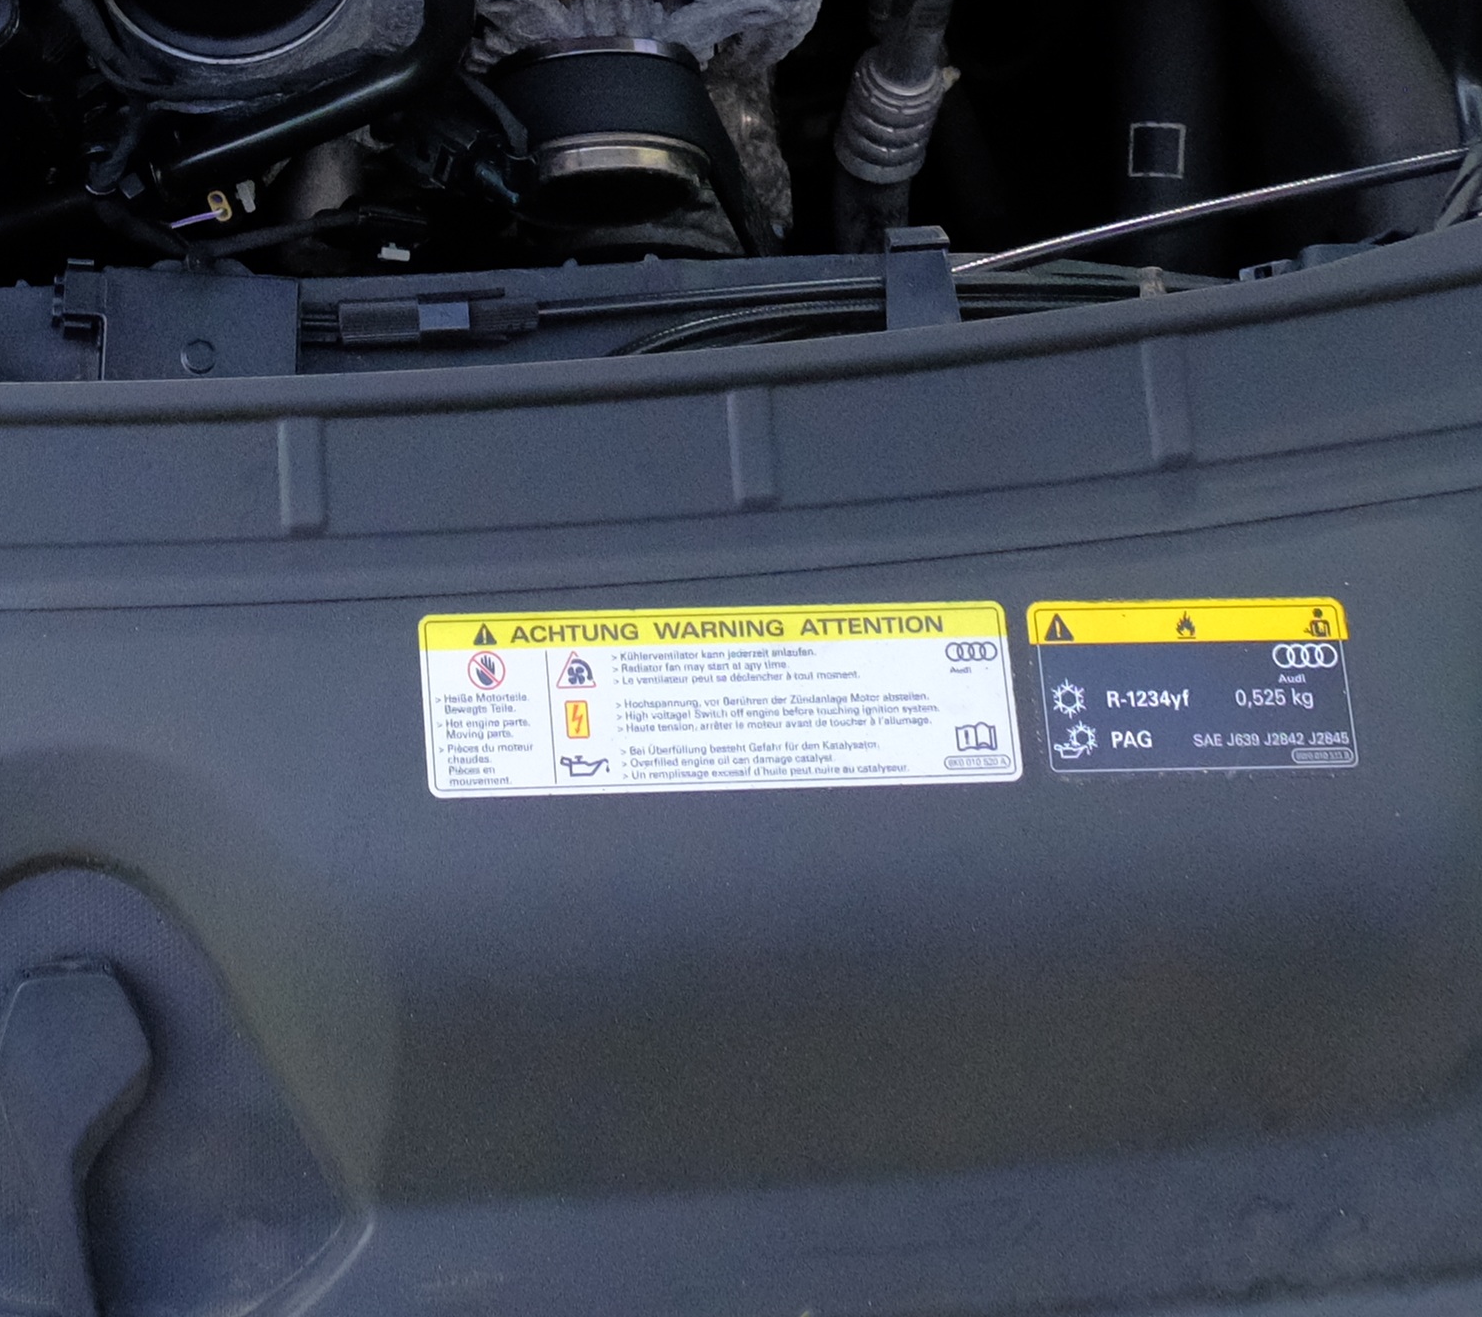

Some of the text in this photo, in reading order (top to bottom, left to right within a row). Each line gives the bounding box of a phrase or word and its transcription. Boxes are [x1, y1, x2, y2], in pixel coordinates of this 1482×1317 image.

[511, 615, 943, 643] ACHTUNG WARNING ATTENTION
[620, 651, 698, 661] Kühlerventilator
[701, 651, 725, 659] kann
[621, 663, 662, 673] Radiator
[665, 662, 682, 672] fan
[683, 663, 705, 672] may
[707, 662, 730, 671] start
[732, 661, 742, 670] at
[744, 662, 762, 672] any
[622, 676, 634, 685] Le
[636, 676, 688, 685] ventilateur
[691, 674, 714, 684] peut
[729, 672, 782, 682] déclencher
[793, 671, 814, 681] tout
[1278, 673, 1306, 683] Audi
[722, 696, 769, 706] Berühren
[770, 696, 787, 705] der
[790, 694, 848, 705] Zündanlage
[850, 693, 880, 703] Motor
[1106, 689, 1189, 708] R-1234yf
[1235, 688, 1314, 709] 0,525 kg
[625, 711, 649, 723] High
[694, 709, 728, 719] Switch
[730, 708, 744, 718] off
[746, 709, 780, 719] engine
[782, 707, 814, 717] before
[816, 706, 860, 716] touching
[862, 705, 900, 716] ignition
[445, 718, 463, 729] Hot
[465, 719, 500, 729] engine
[625, 724, 656, 733] Haute
[735, 720, 745, 730] le
[747, 721, 782, 729] moteur
[785, 719, 813, 728] avant
[814, 718, 828, 728] de
[829, 718, 867, 727] toucher
[446, 729, 485, 740] Moving
[1111, 730, 1153, 749] PAG
[1193, 731, 1350, 748] SAE J639 J2842 J2845
[447, 743, 533, 754] Pièces du moteur
[629, 745, 646, 756] Bei
[648, 745, 707, 755] Überfüllung
[709, 744, 746, 754] besteht
[748, 742, 782, 753] Gefahr
[784, 741, 798, 752] für
[801, 742, 820, 751] den
[630, 757, 679, 768] Overfilled
[681, 758, 715, 768] engine
[717, 755, 730, 766] oil
[732, 757, 750, 765] can
[752, 756, 793, 765] damage
[448, 765, 496, 776] Pièces en
[631, 770, 647, 780] Un
[648, 770, 709, 780] remplissage
[789, 766, 812, 776] peut
[814, 766, 841, 775] nuire
[842, 765, 855, 774] au
